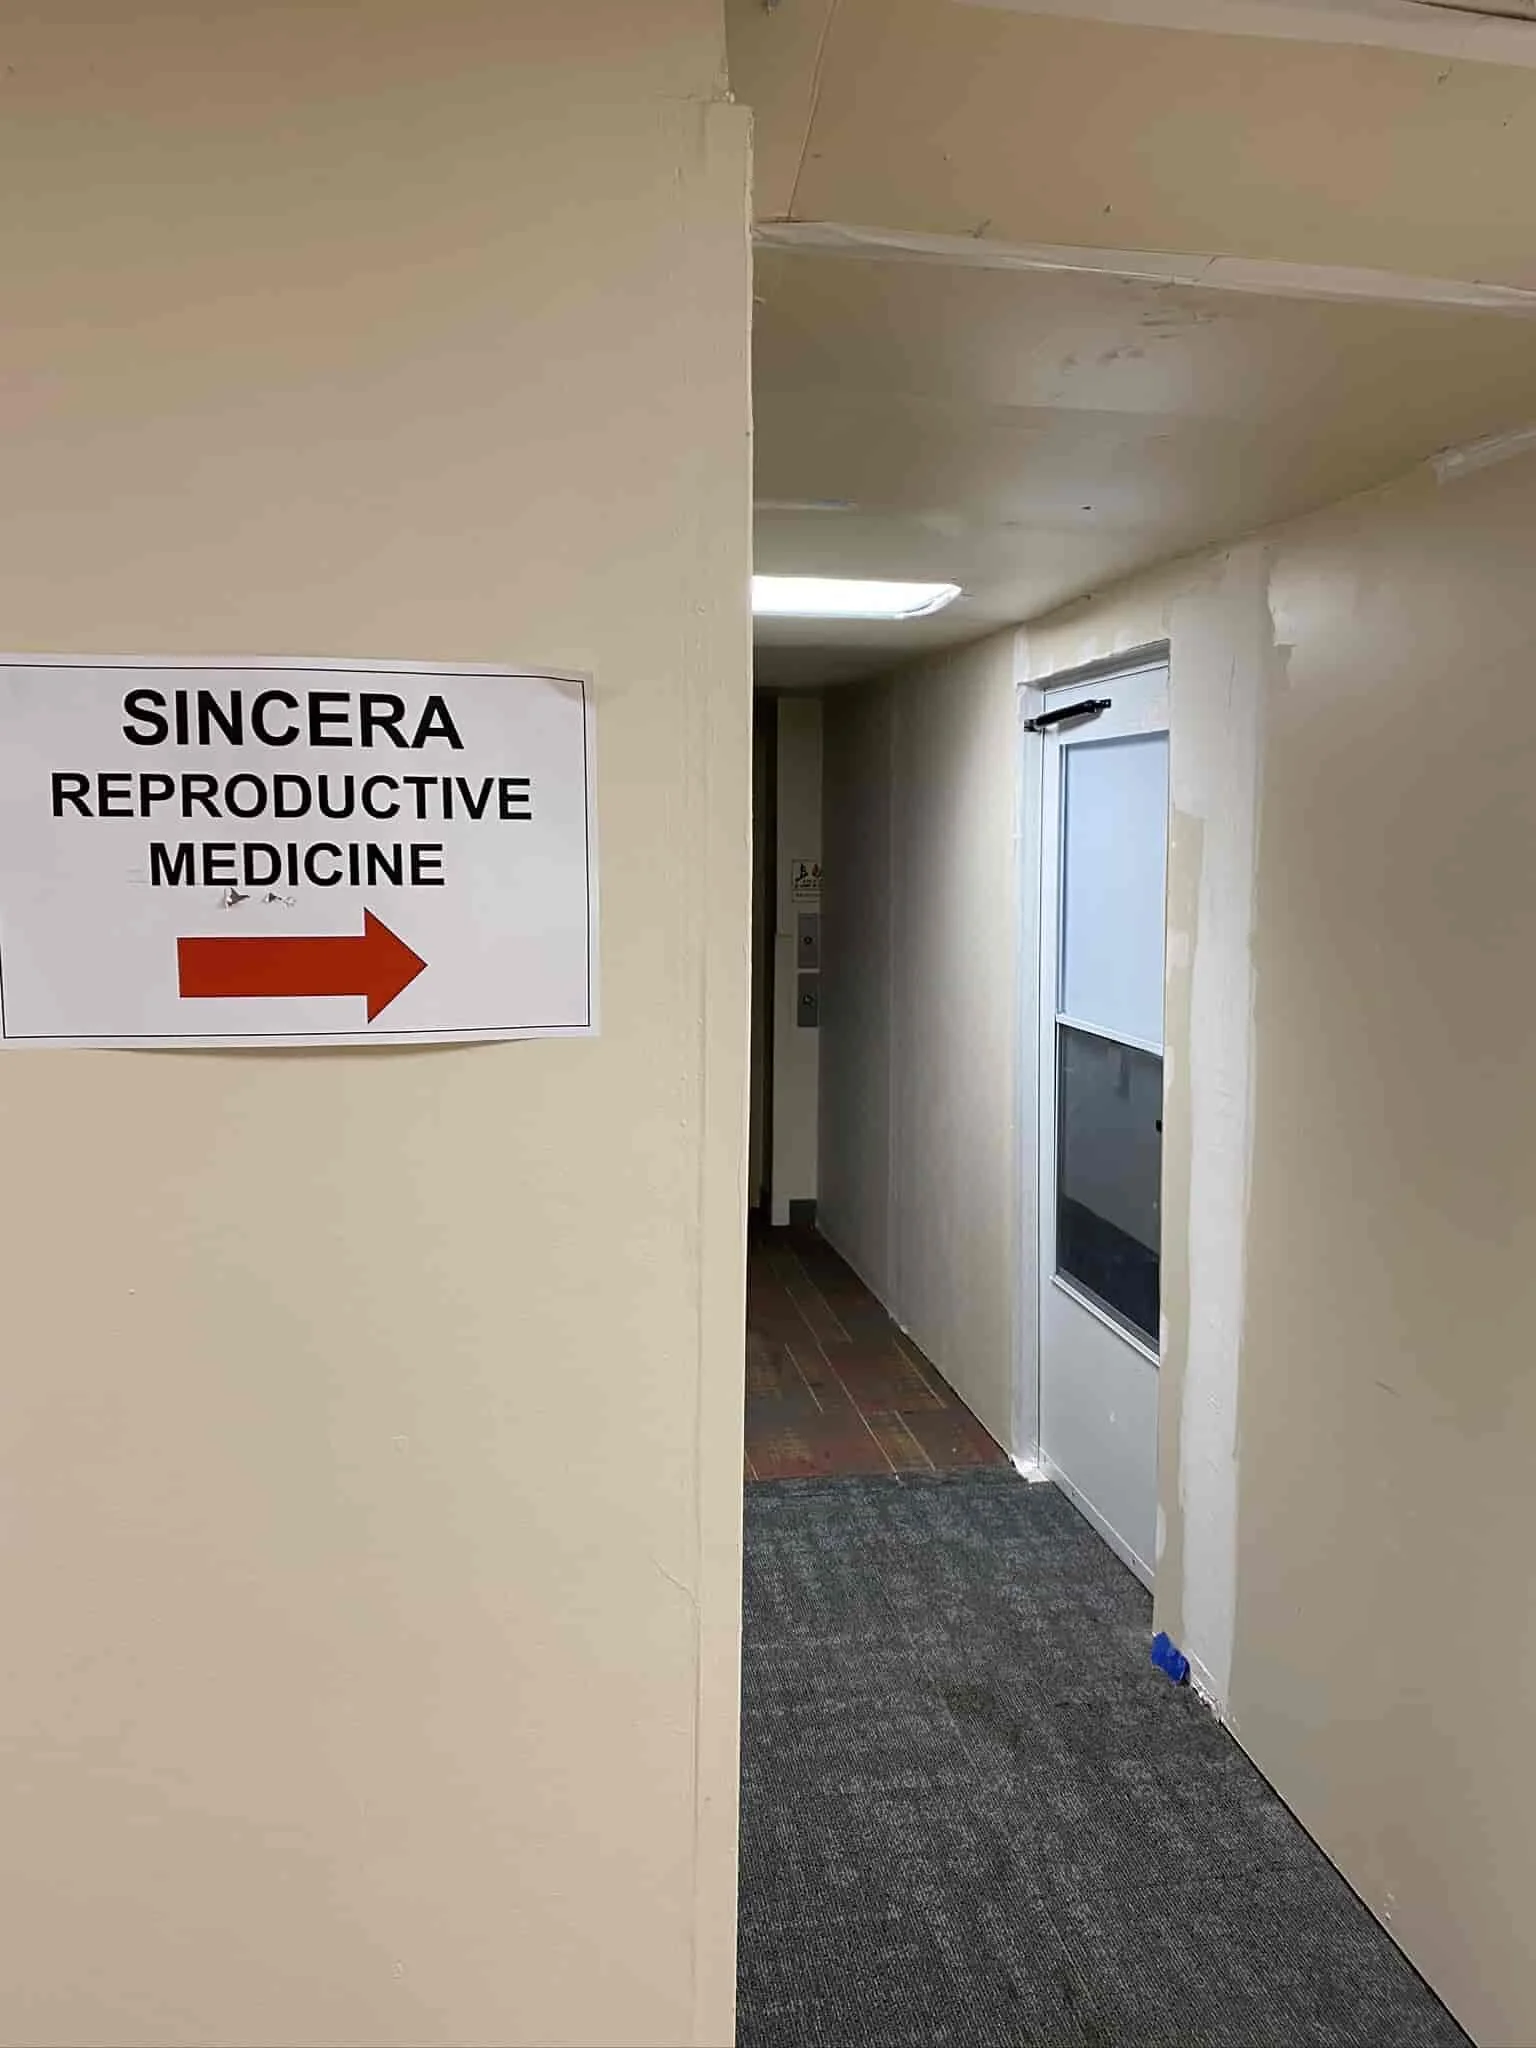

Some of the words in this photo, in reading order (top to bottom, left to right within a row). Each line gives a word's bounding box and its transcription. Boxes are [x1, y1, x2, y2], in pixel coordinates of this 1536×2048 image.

[122, 689, 465, 750] SINCERA
[51, 772, 532, 820] REPRODUCTIVE
[150, 842, 445, 887] MEDICINE
